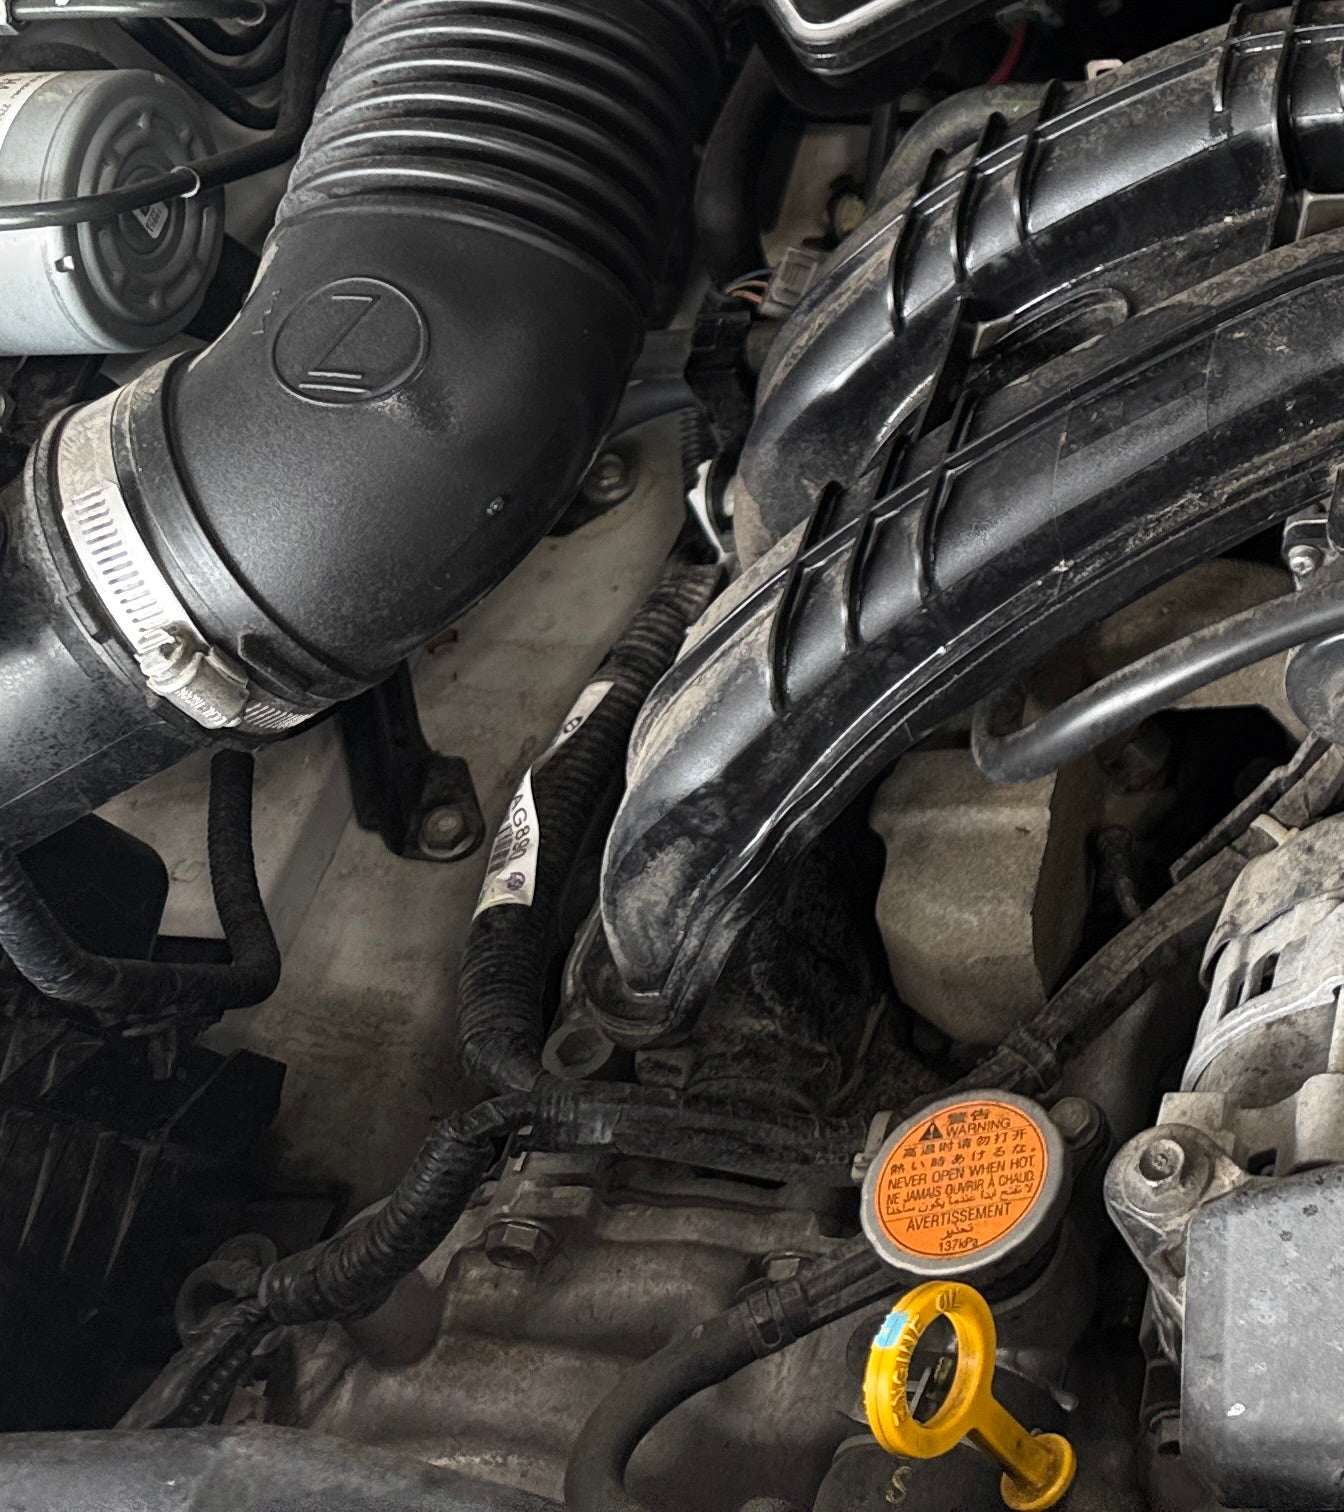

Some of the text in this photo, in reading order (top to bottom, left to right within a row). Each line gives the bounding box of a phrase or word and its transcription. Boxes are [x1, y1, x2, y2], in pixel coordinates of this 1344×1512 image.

[945, 1118, 1011, 1138] WARNING
[888, 1172, 926, 1190] NEVER
[932, 1166, 964, 1183] OPEN
[969, 1159, 1005, 1177] WHEN
[886, 1192, 900, 1205] NE
[903, 1184, 941, 1202] JAMAIS
[945, 1178, 983, 1196] OUVRIR
[906, 1200, 1011, 1233] AVERTISSEMENT
[939, 1234, 978, 1253] 137kPa
